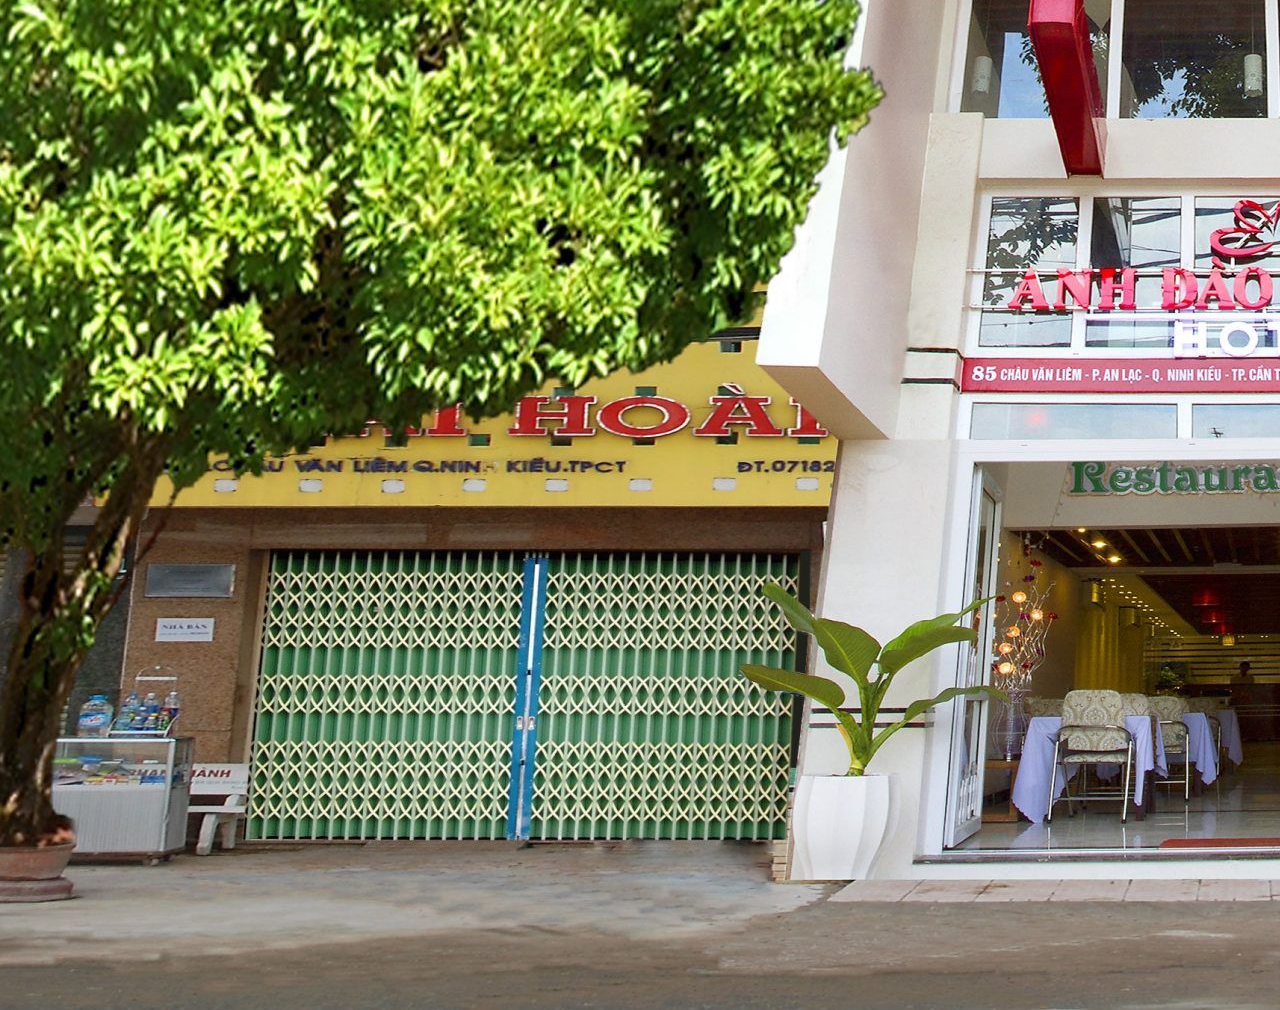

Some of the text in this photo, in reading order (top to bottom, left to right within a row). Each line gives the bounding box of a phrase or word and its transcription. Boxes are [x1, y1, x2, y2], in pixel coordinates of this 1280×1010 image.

[1008, 267, 1137, 310] ANH
[971, 365, 997, 381] 85
[1000, 367, 1029, 381] CHÂU
[1032, 367, 1054, 381] VĂN
[1055, 367, 1082, 381] LIÊM
[1103, 368, 1119, 381] AN
[1122, 368, 1142, 384] LẠC
[1167, 368, 1194, 381] NINH
[1232, 368, 1247, 381] TP.
[507, 382, 829, 438] HOÀ
[294, 459, 343, 472] VĂN
[353, 457, 408, 472] LIÊM
[413, 459, 498, 473] Q.NIN
